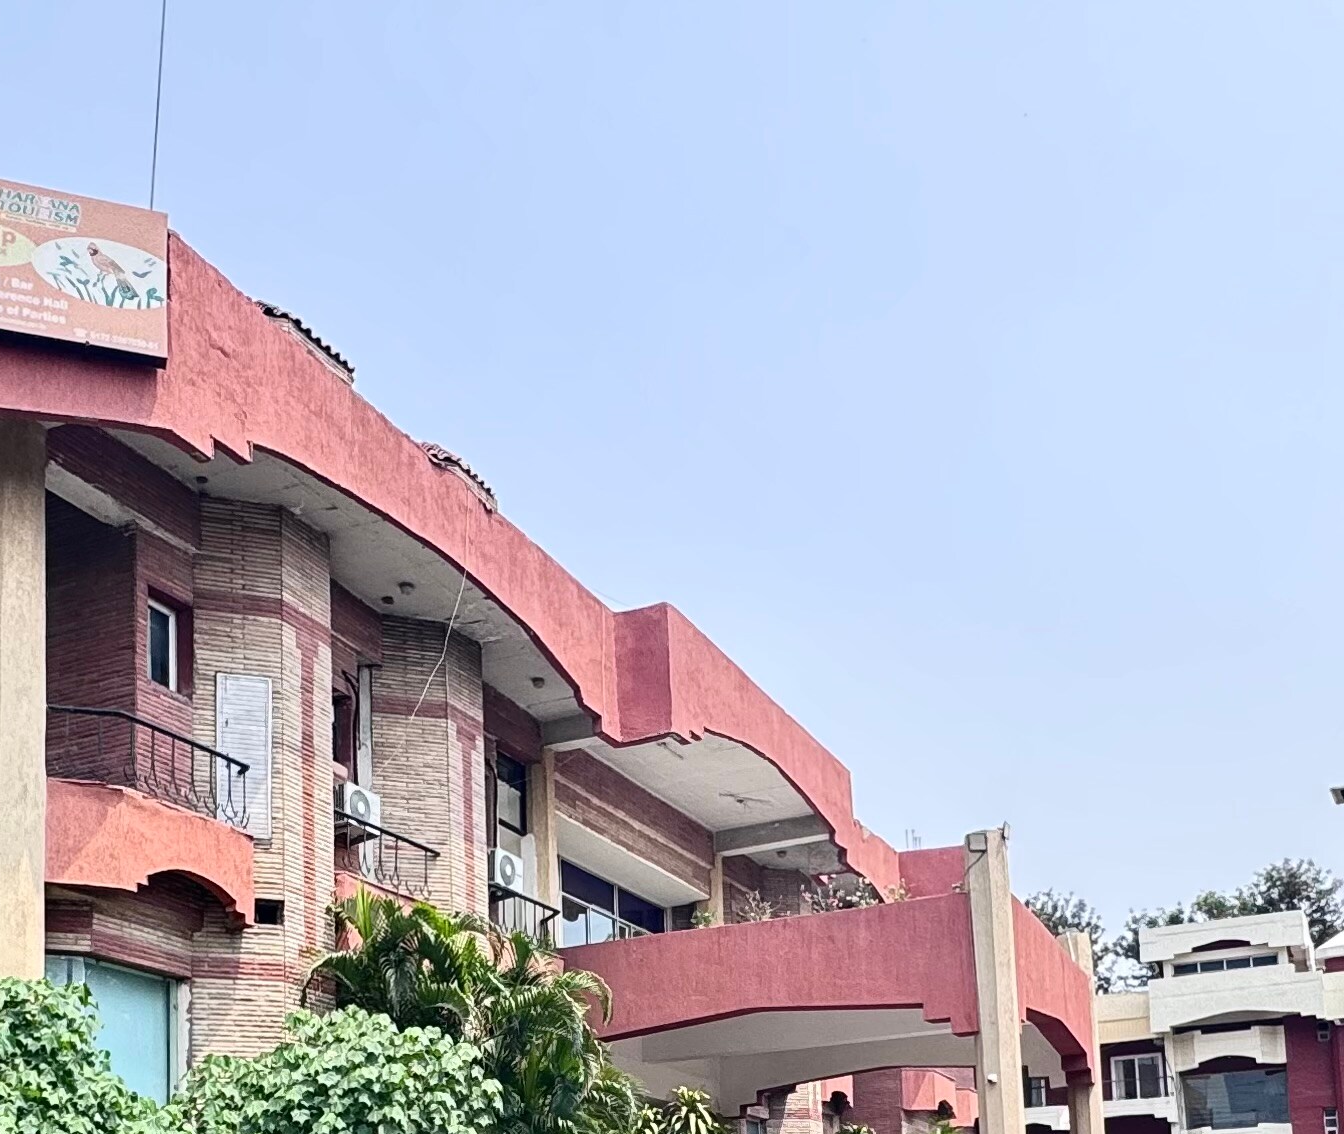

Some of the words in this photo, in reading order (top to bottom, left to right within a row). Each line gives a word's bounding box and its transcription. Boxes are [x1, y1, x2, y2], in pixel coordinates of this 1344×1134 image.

[11, 277, 33, 291] Bar
[43, 298, 68, 310] Hall
[7, 305, 19, 317] of
[22, 308, 66, 324] Parties
